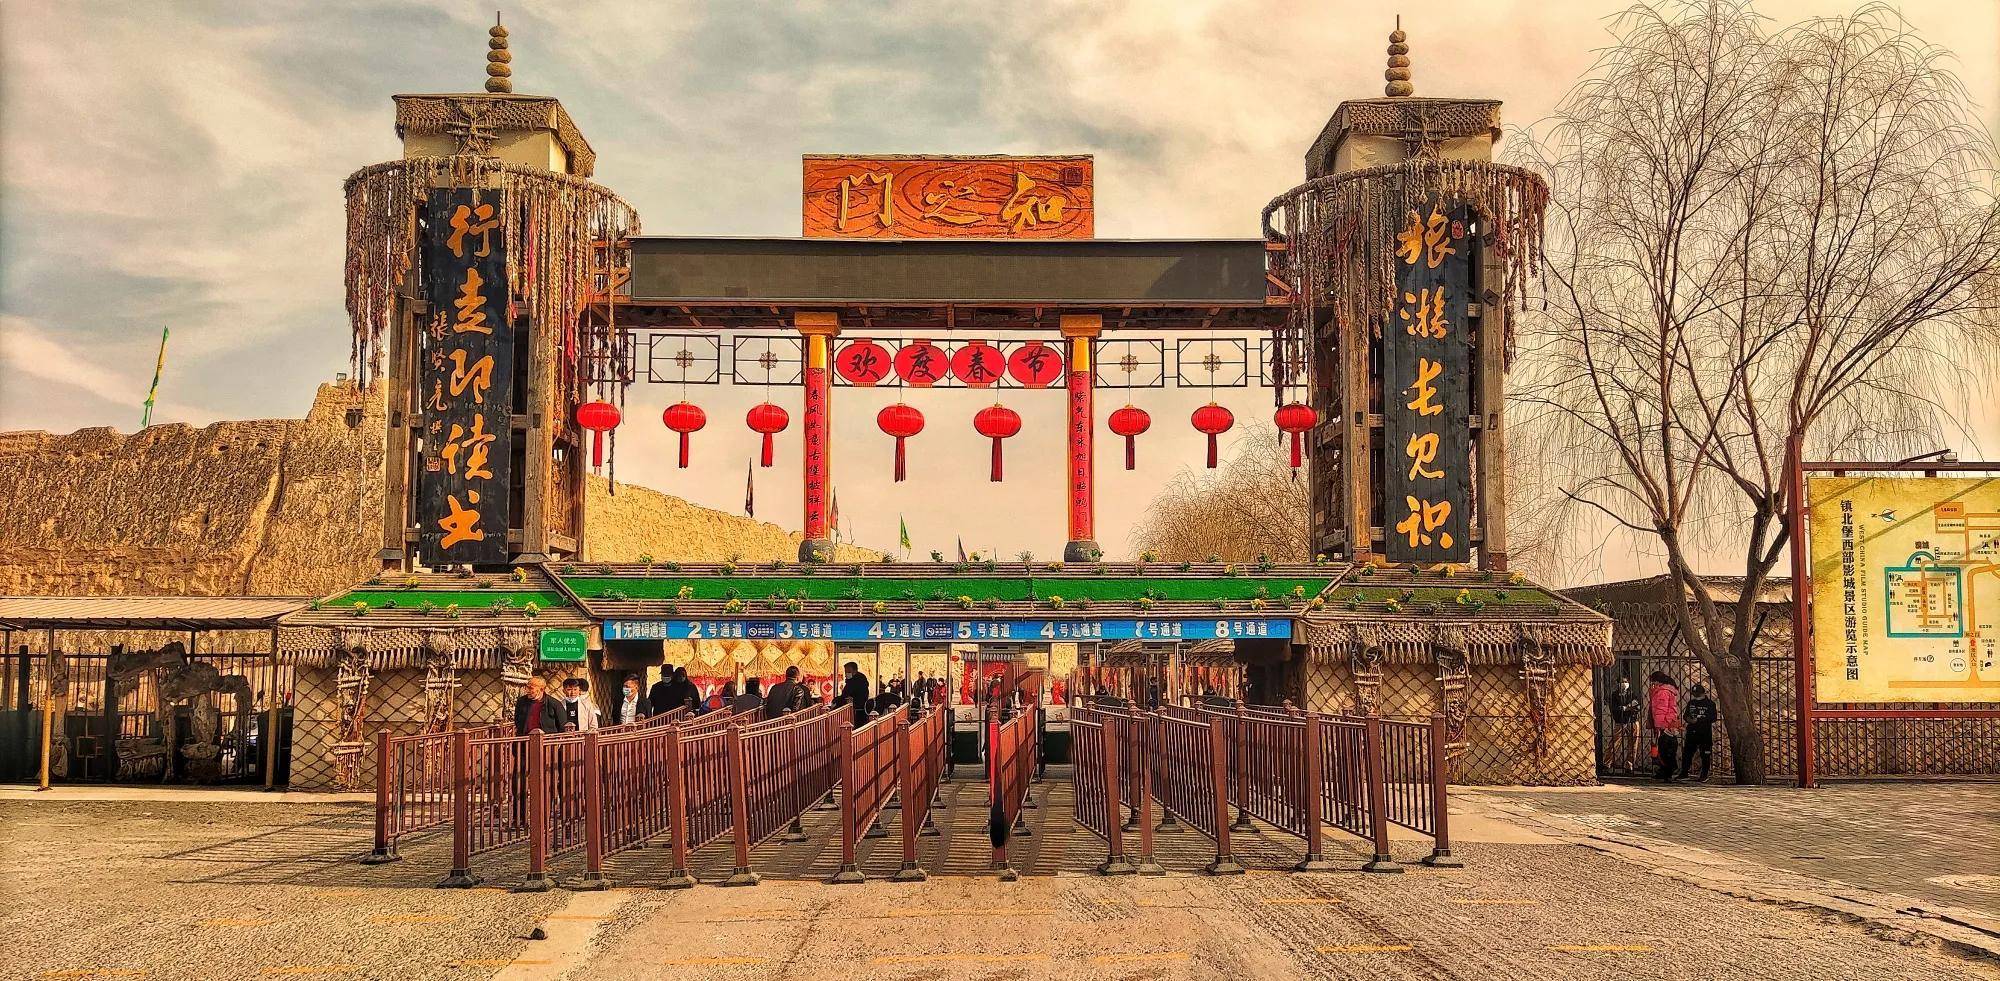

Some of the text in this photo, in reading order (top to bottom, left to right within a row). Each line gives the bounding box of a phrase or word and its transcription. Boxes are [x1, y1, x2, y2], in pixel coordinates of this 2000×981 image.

[849, 346, 1050, 383] 欢度春节
[1840, 499, 1859, 681] 镇北堡西部影城景区游览示意图
